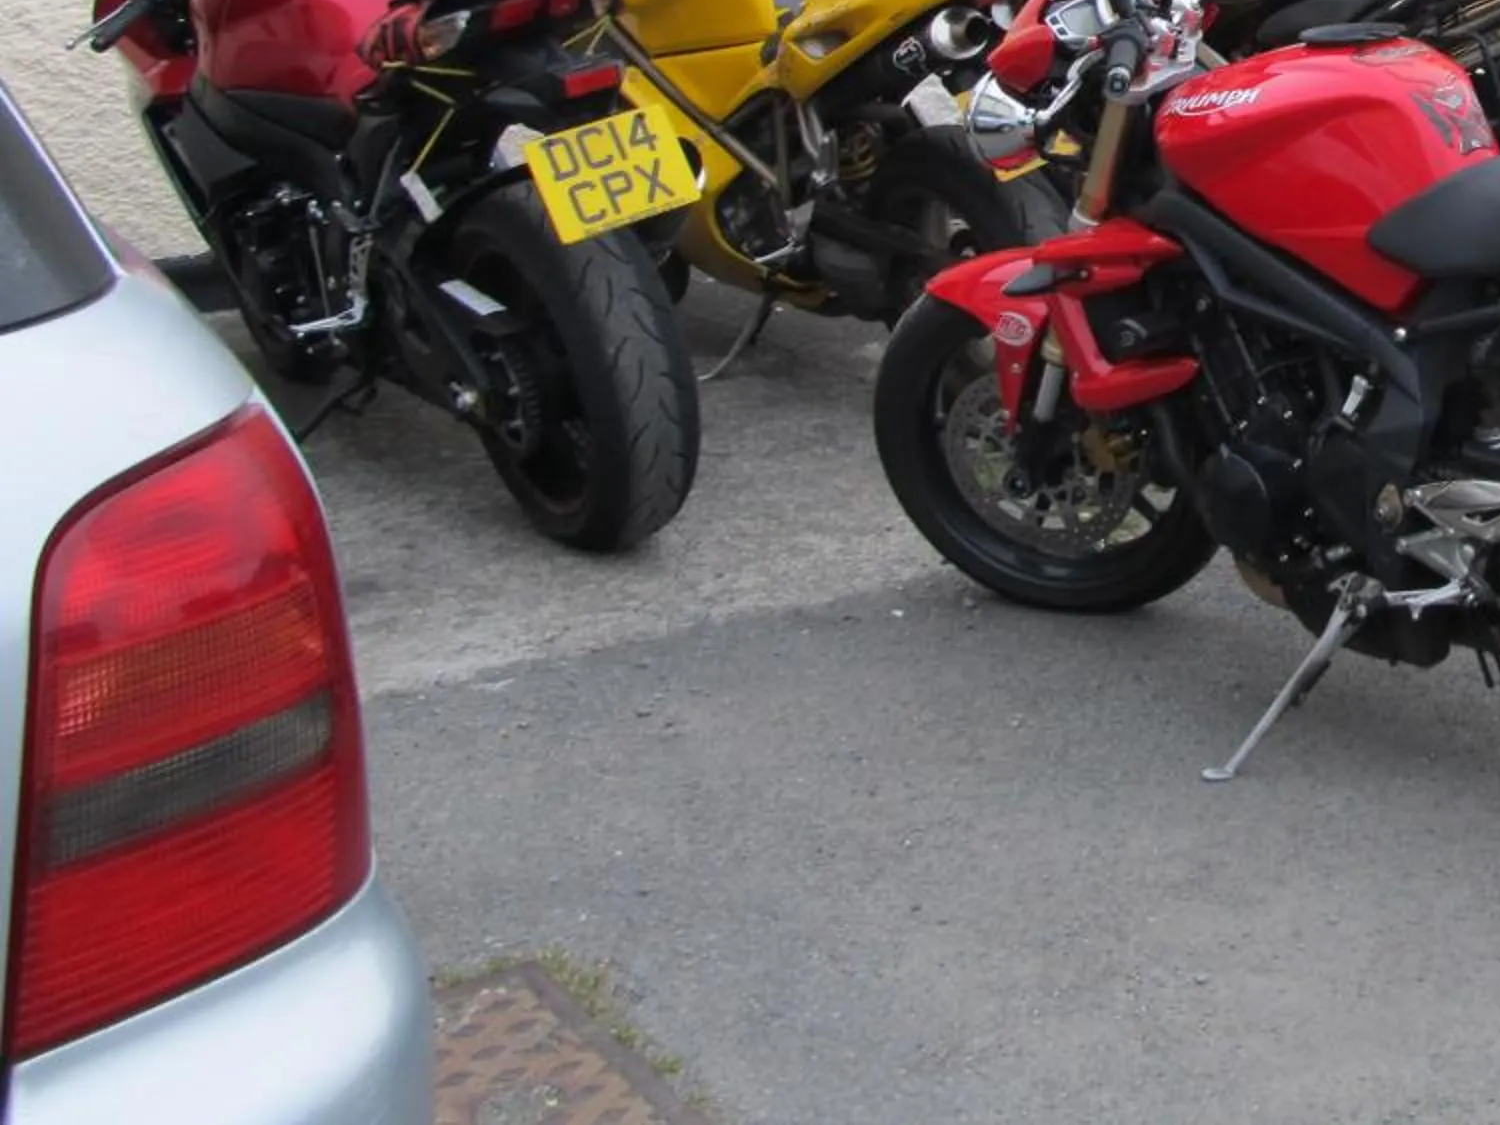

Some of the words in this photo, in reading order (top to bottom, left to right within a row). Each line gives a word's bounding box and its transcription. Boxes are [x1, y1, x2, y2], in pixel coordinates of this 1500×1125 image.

[1164, 88, 1261, 116] TRIUMPH
[541, 112, 657, 181] DC14
[568, 158, 676, 224] CPX
